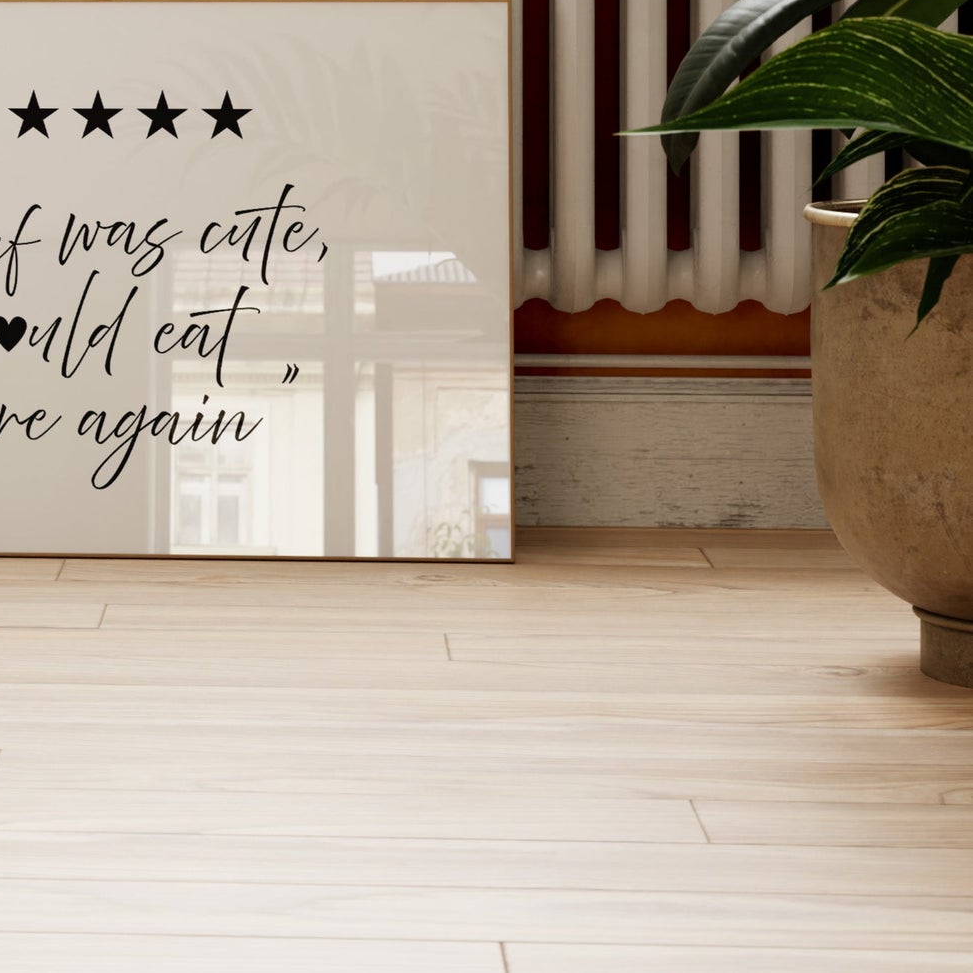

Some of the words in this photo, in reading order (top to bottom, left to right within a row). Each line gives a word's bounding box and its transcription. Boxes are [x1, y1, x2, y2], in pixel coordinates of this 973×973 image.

[58, 213, 183, 277] was
[199, 184, 329, 285] cute,
[154, 285, 261, 387] eat
[77, 394, 264, 490] again
